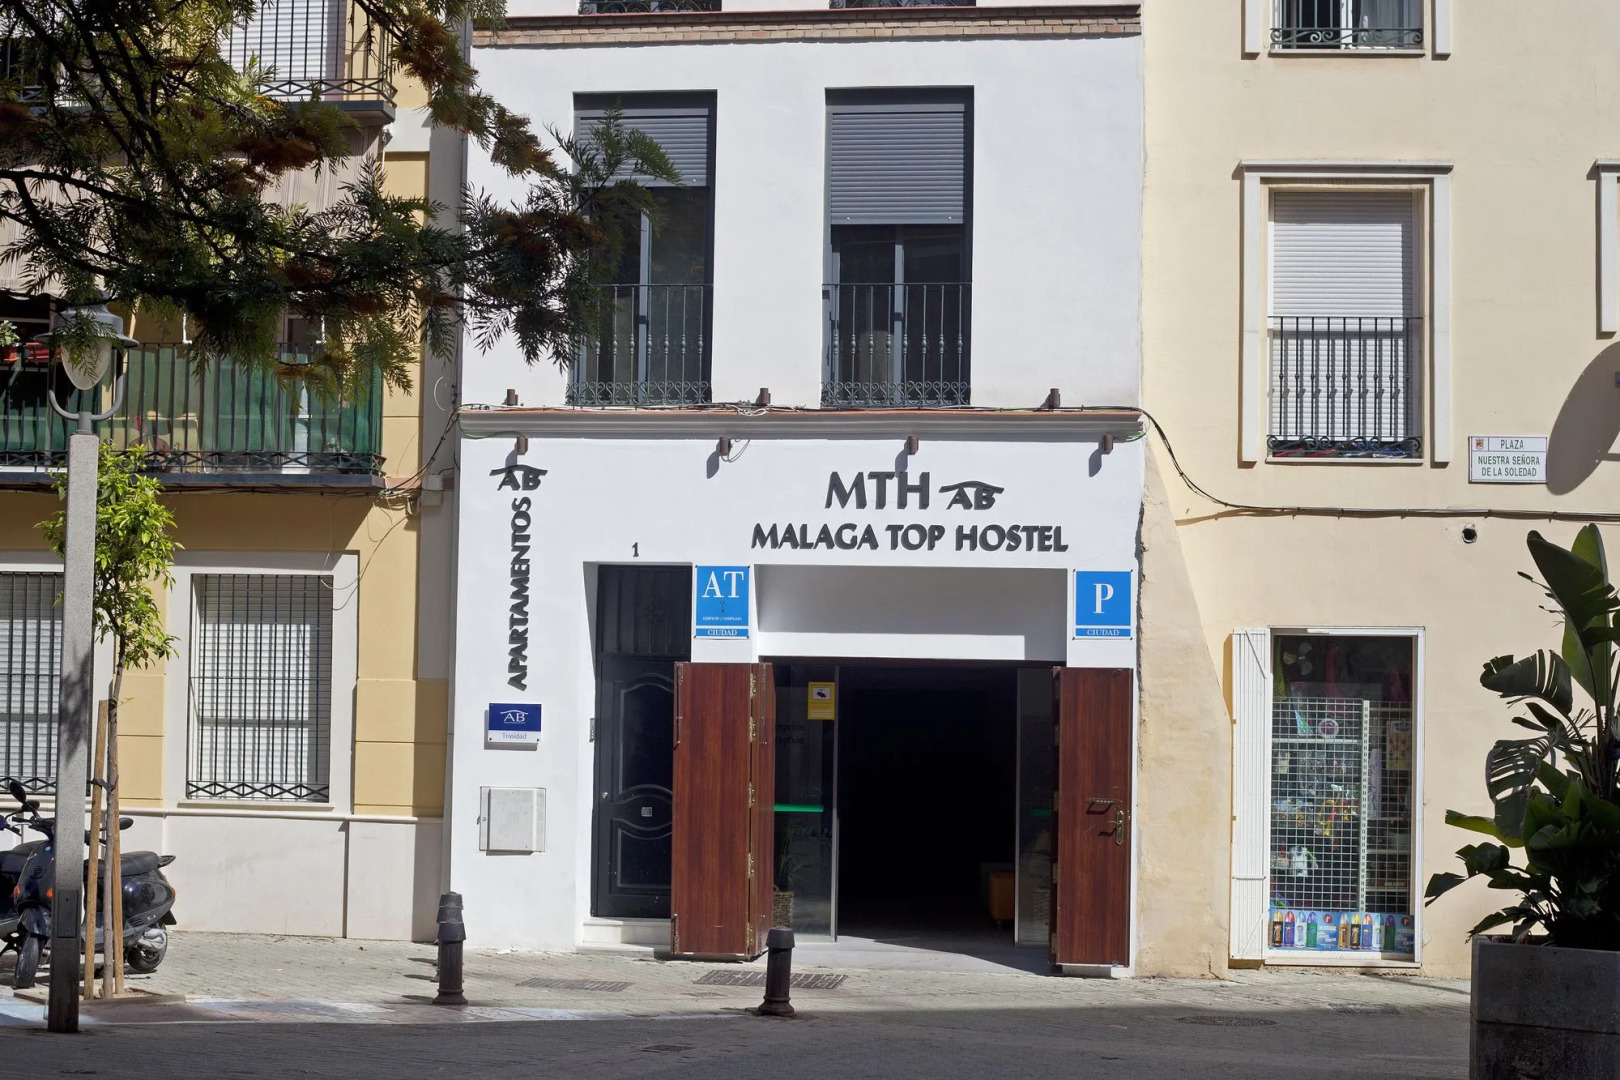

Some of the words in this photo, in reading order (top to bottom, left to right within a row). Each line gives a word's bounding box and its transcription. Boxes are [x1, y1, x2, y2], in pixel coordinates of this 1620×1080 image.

[1500, 439, 1524, 450] PLAZA
[1478, 455, 1510, 465] NUESTRA
[1512, 454, 1540, 466] SEÑORA
[495, 466, 543, 491] AB
[1481, 467, 1491, 477] DE
[1493, 467, 1502, 477] LA
[1504, 467, 1537, 477] SOLEDAD
[824, 471, 930, 510] MTH
[945, 484, 997, 510] AB
[751, 523, 879, 550] MALAGA
[885, 523, 945, 551] TOP
[955, 524, 1069, 552] HOSTEL
[632, 542, 640, 557] 1
[507, 496, 532, 692] APARTAMENTOS
[701, 570, 744, 598] AT
[1092, 583, 1114, 614] P
[502, 711, 526, 722] AB
[502, 732, 527, 740] Trinidad
